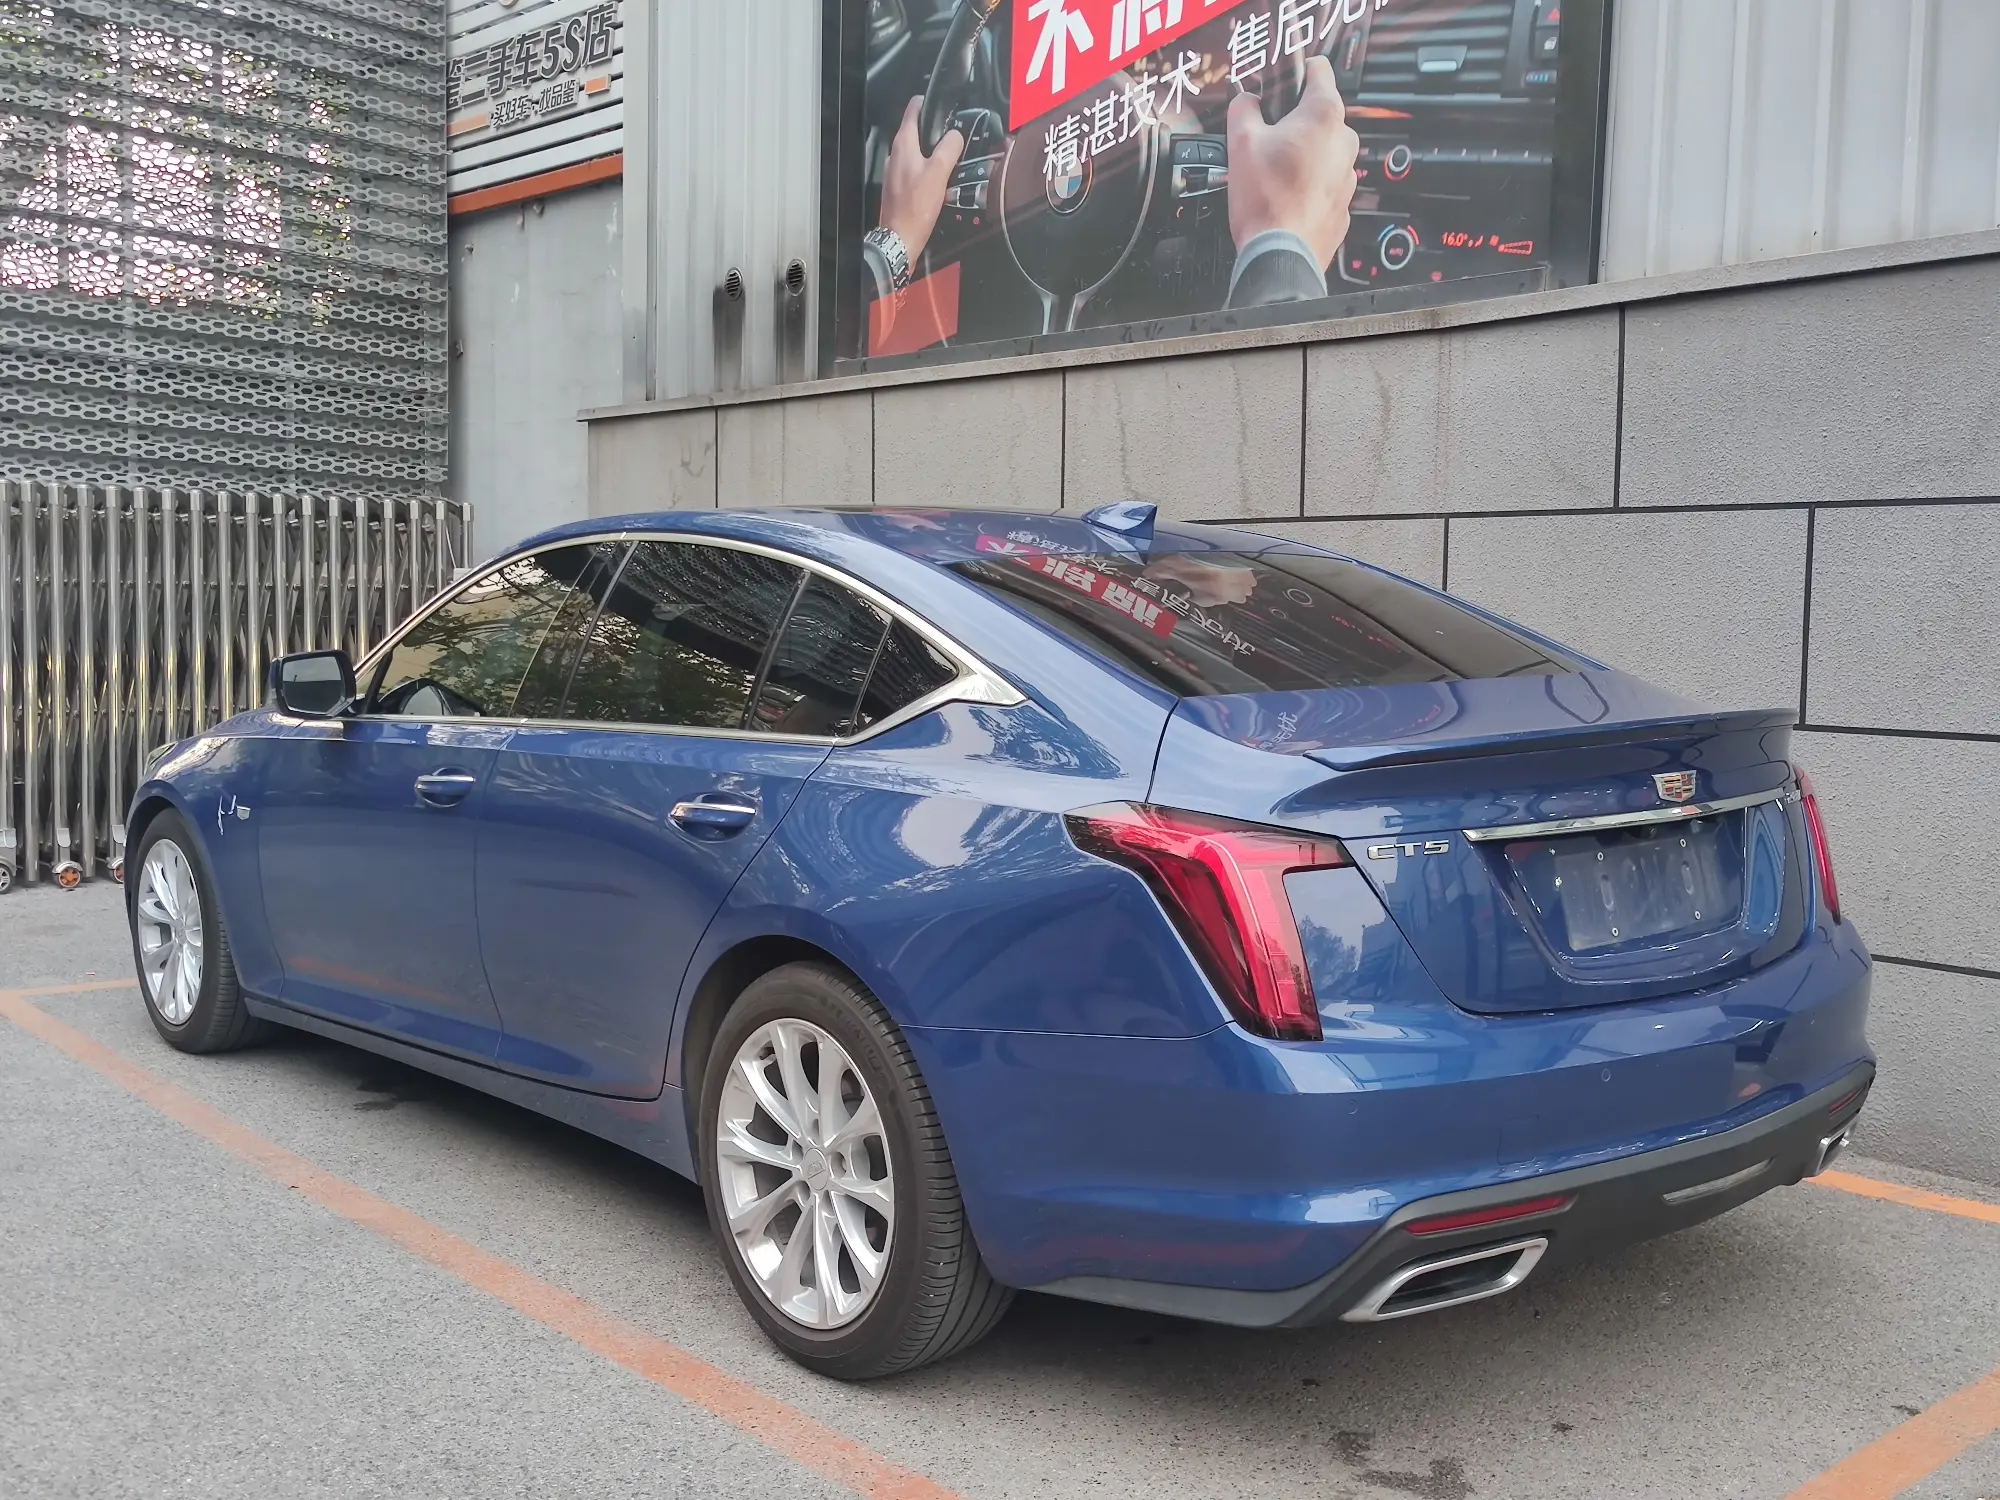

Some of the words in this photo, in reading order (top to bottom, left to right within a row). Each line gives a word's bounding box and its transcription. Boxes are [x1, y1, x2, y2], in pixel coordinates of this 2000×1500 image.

[1043, 50, 1201, 181] 精湛技术
[1367, 840, 1450, 860] CT5
